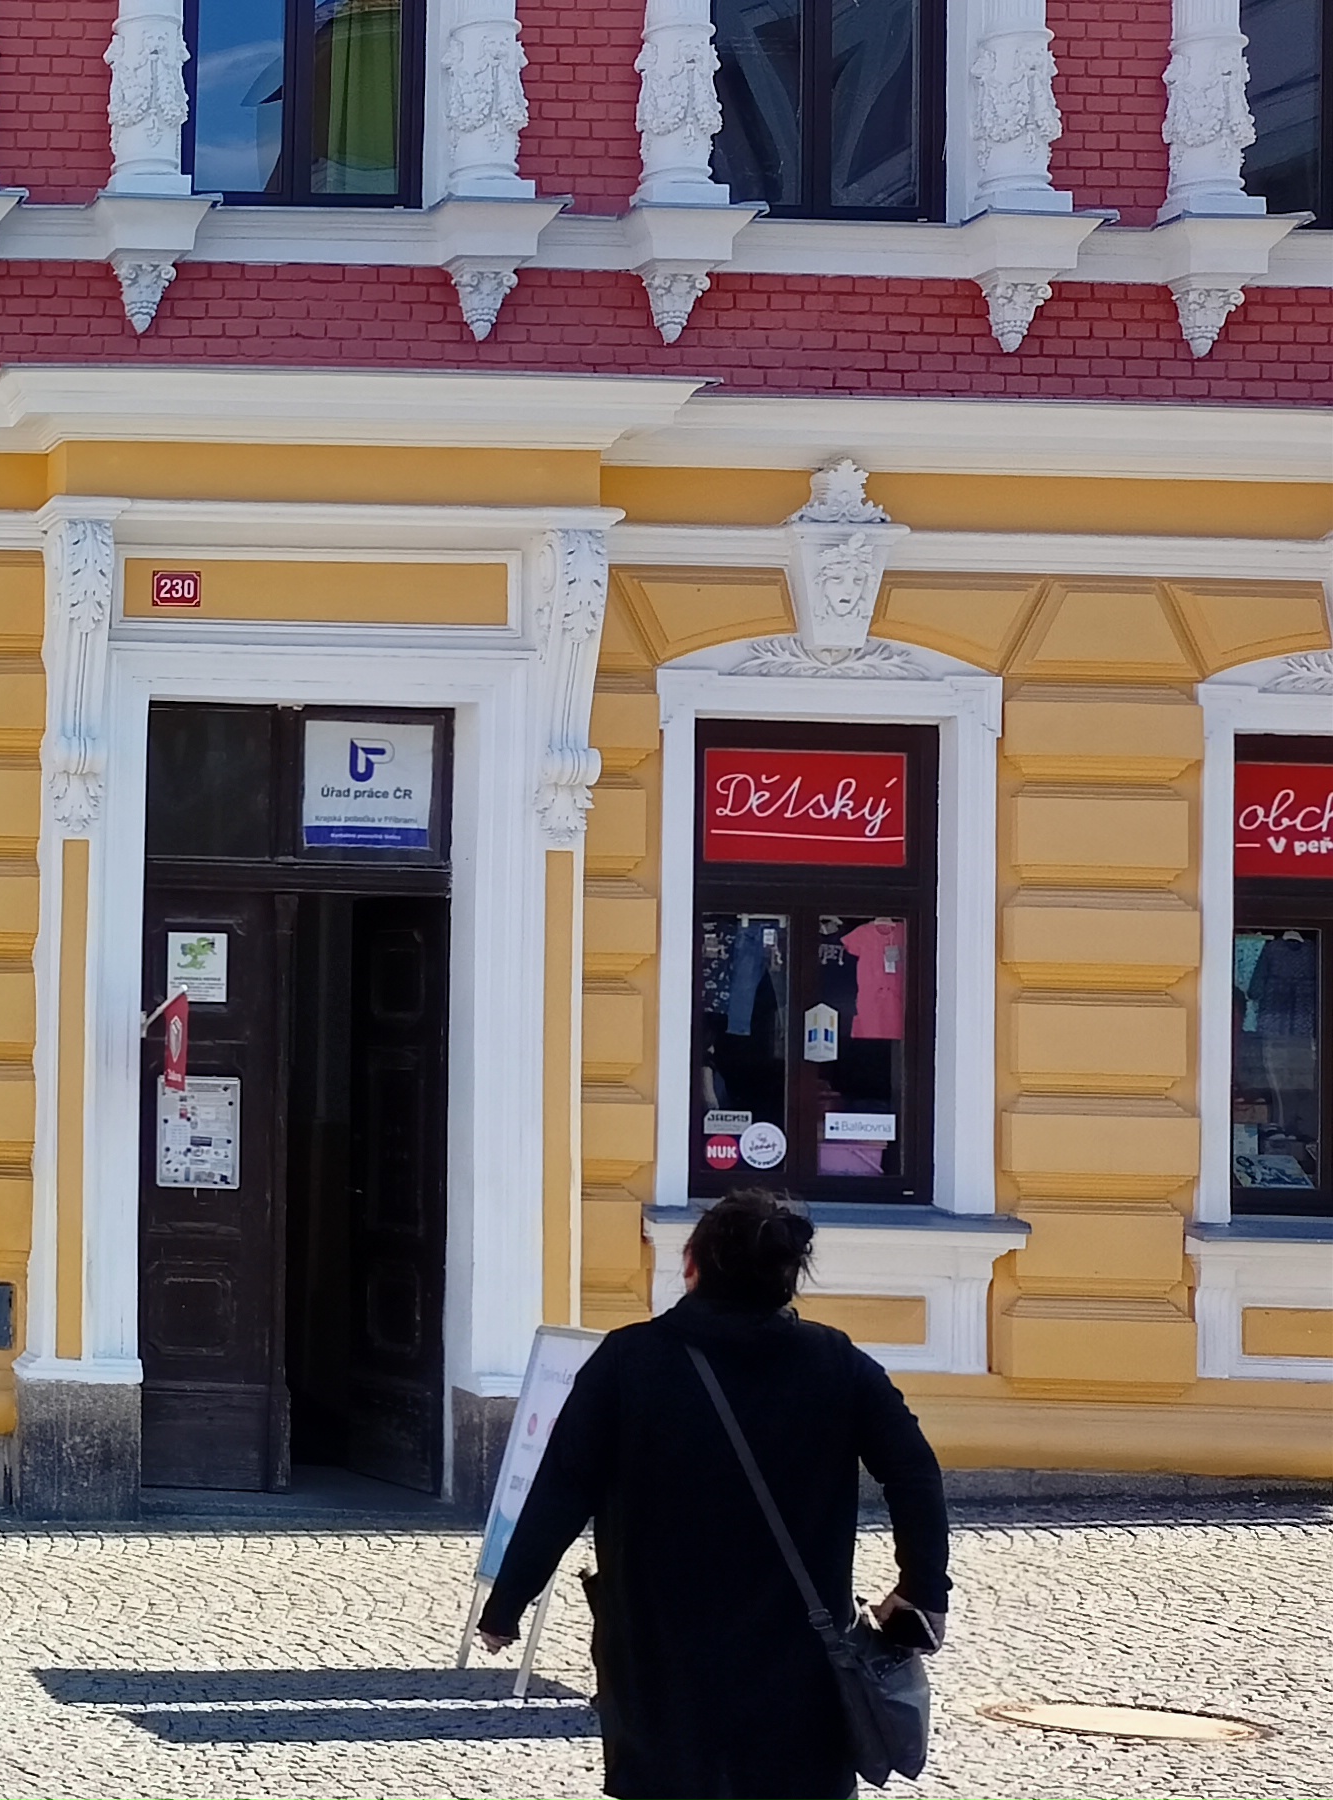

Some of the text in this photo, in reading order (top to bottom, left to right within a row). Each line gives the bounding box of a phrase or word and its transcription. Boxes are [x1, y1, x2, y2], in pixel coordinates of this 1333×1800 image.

[159, 579, 195, 599] 230
[321, 784, 413, 800] Úřad práce ČR
[1267, 836, 1287, 854] V
[841, 1120, 892, 1133] Balíkovna
[706, 1145, 738, 1159] NUK
